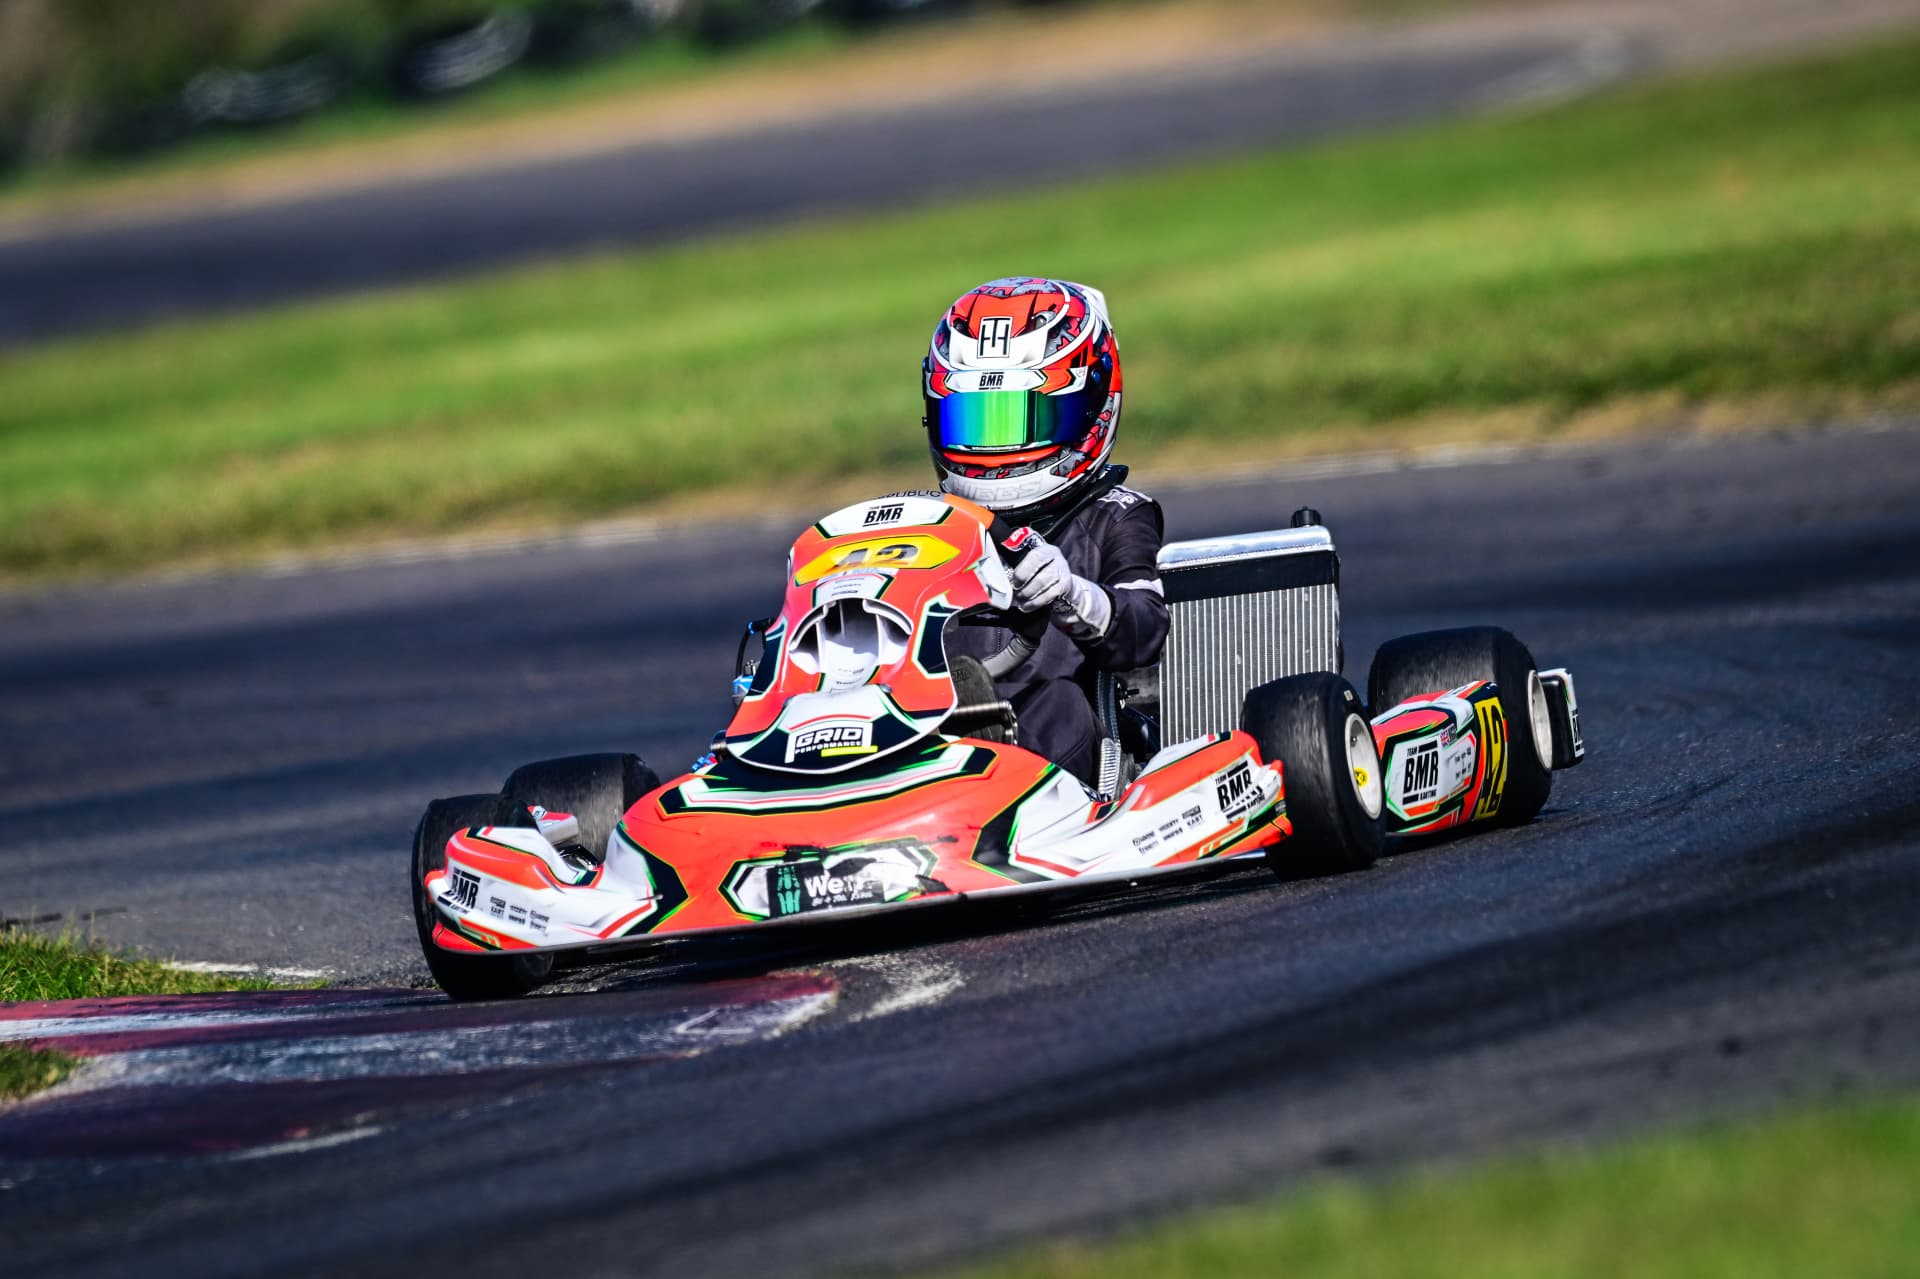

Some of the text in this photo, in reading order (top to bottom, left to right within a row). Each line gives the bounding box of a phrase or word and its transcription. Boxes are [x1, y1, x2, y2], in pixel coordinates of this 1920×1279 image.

[979, 374, 1004, 387] BMR
[863, 507, 904, 524] BMR
[796, 728, 862, 748] GRID
[794, 740, 864, 755] PERFORMANCE
[1403, 750, 1439, 795] BMR
[1216, 768, 1264, 812] BMR
